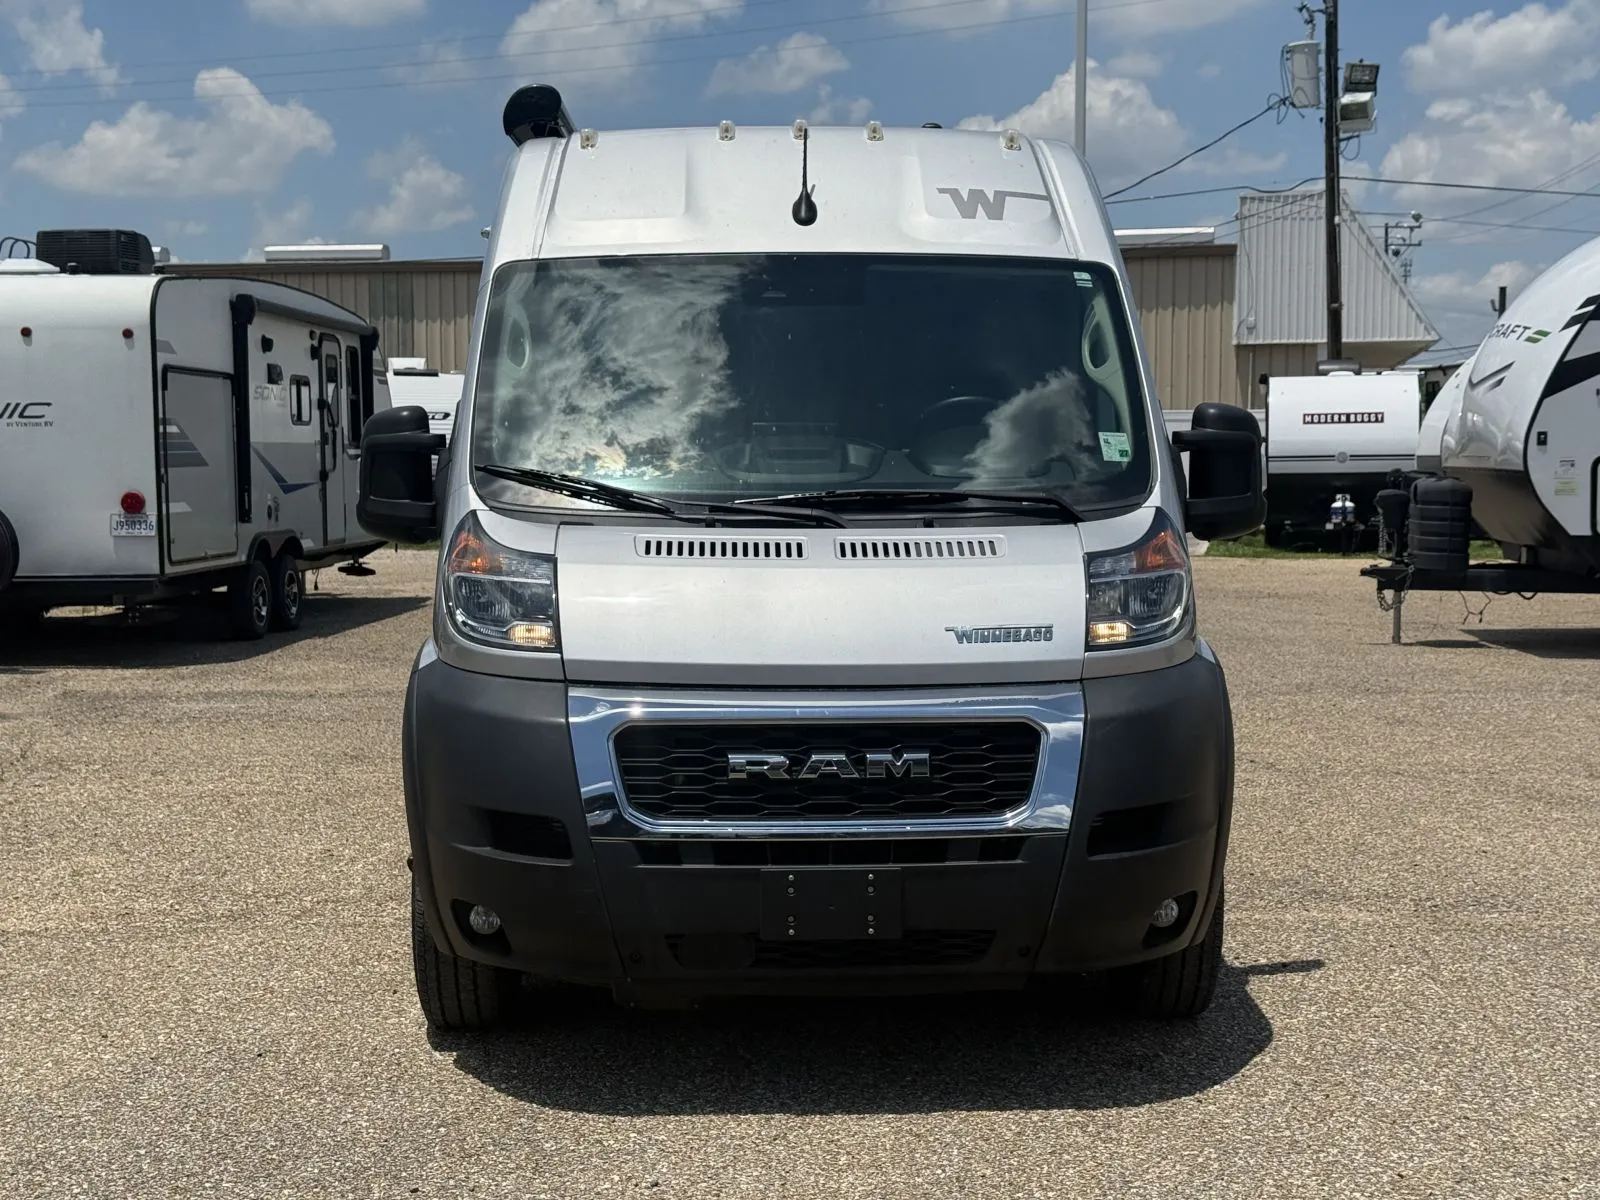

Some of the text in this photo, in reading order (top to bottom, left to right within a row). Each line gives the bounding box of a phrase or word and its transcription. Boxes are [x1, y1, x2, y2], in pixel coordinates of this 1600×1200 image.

[1304, 413, 1383, 424] MODERN BUGGY
[945, 624, 1053, 644] WINNEBAGO
[728, 753, 930, 779] RAM
